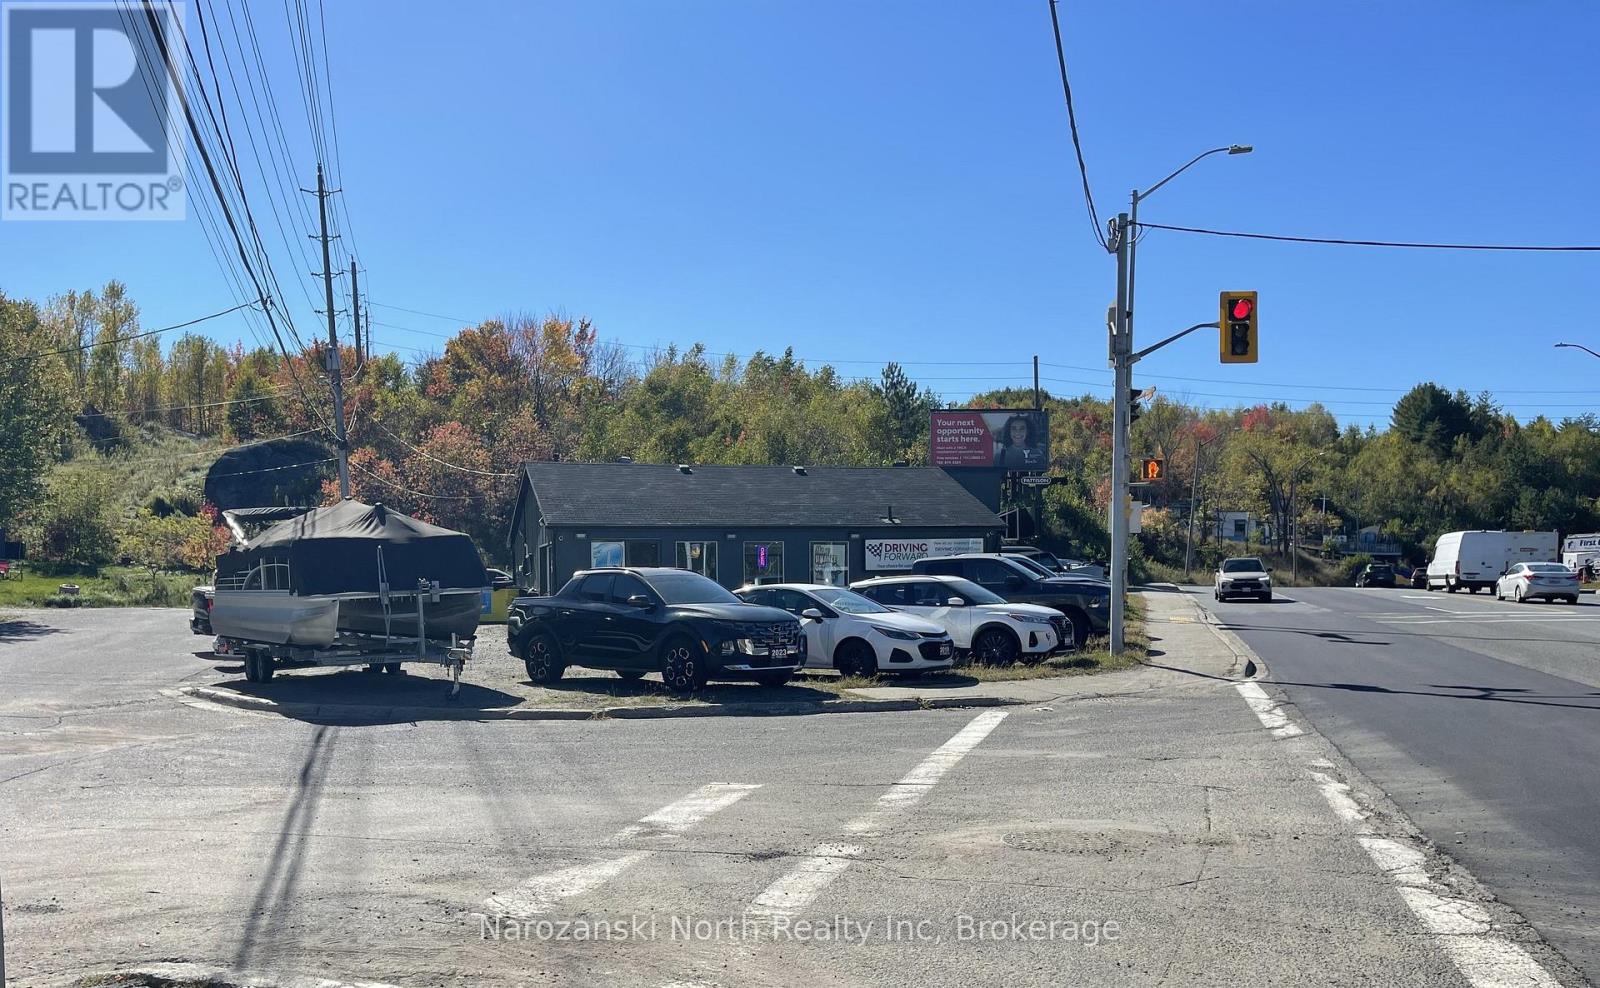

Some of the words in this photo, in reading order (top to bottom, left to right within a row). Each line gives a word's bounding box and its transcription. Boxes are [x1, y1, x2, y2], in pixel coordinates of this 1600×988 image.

[936, 428, 984, 436] opportunity
[884, 543, 928, 552] DRIVING
[884, 552, 928, 560] FORWARD
